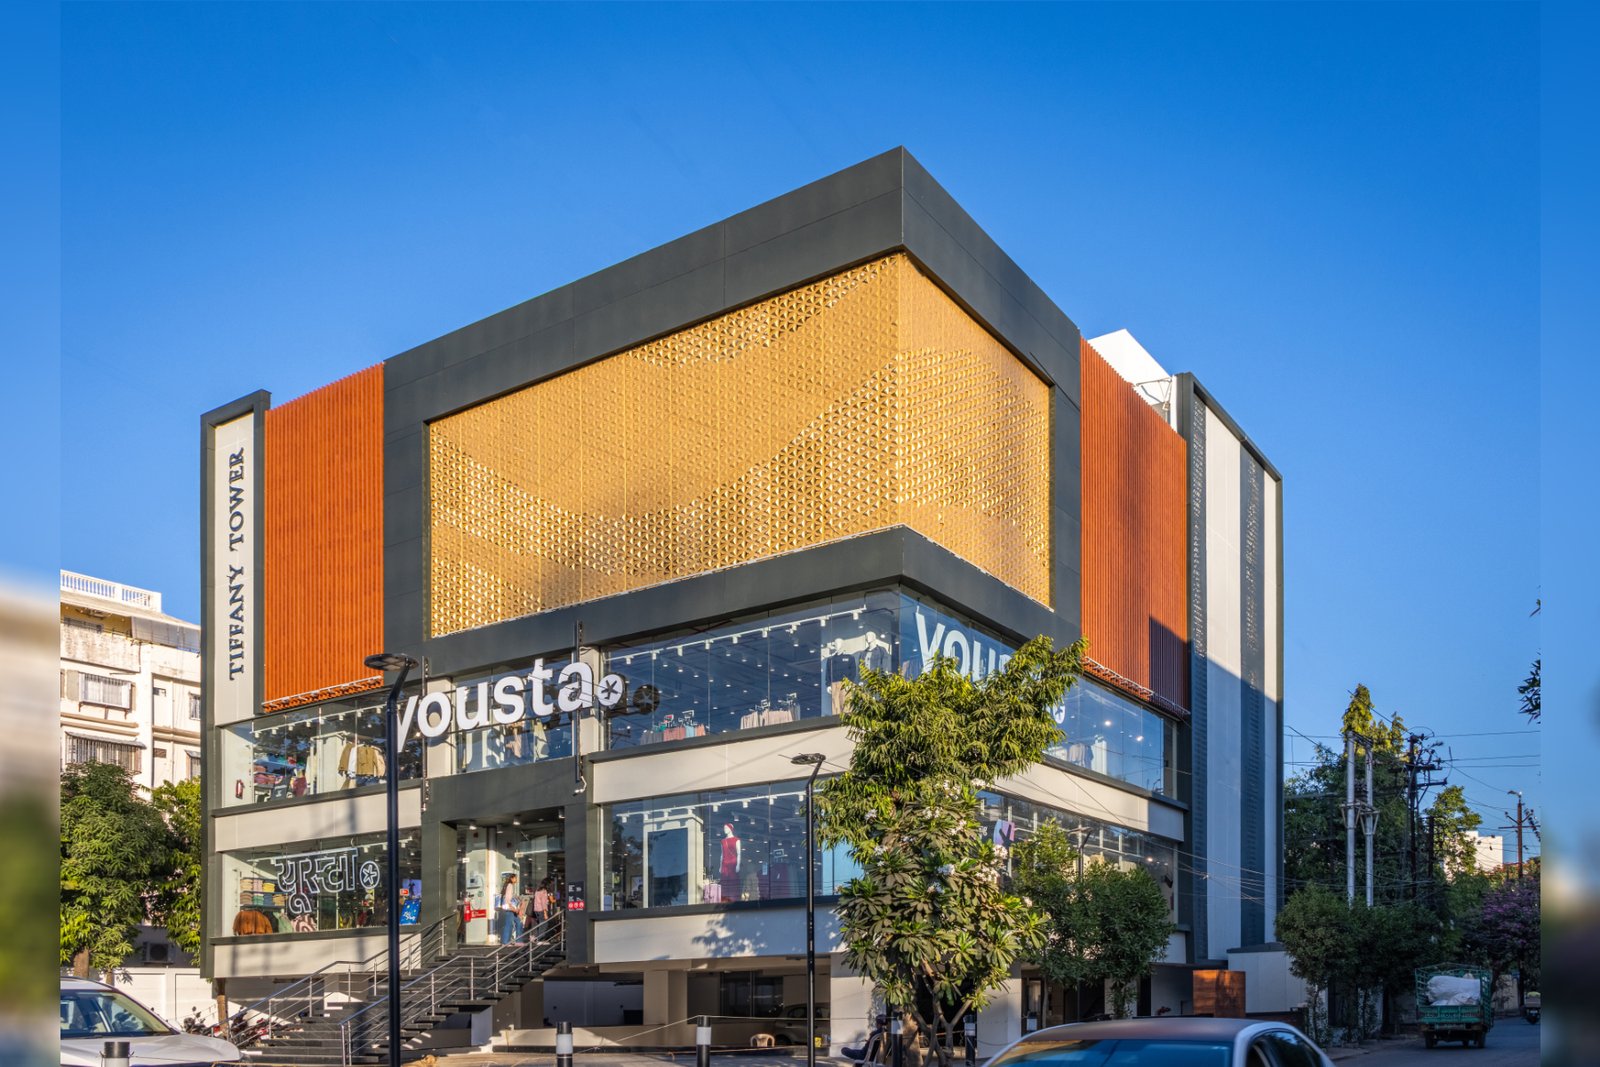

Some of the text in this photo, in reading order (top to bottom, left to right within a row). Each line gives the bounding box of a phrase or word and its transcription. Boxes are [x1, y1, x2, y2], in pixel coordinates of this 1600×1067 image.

[229, 447, 244, 681] TIFFANY TOWER
[397, 658, 594, 753] yousta
[275, 847, 359, 914] यूस्टा
